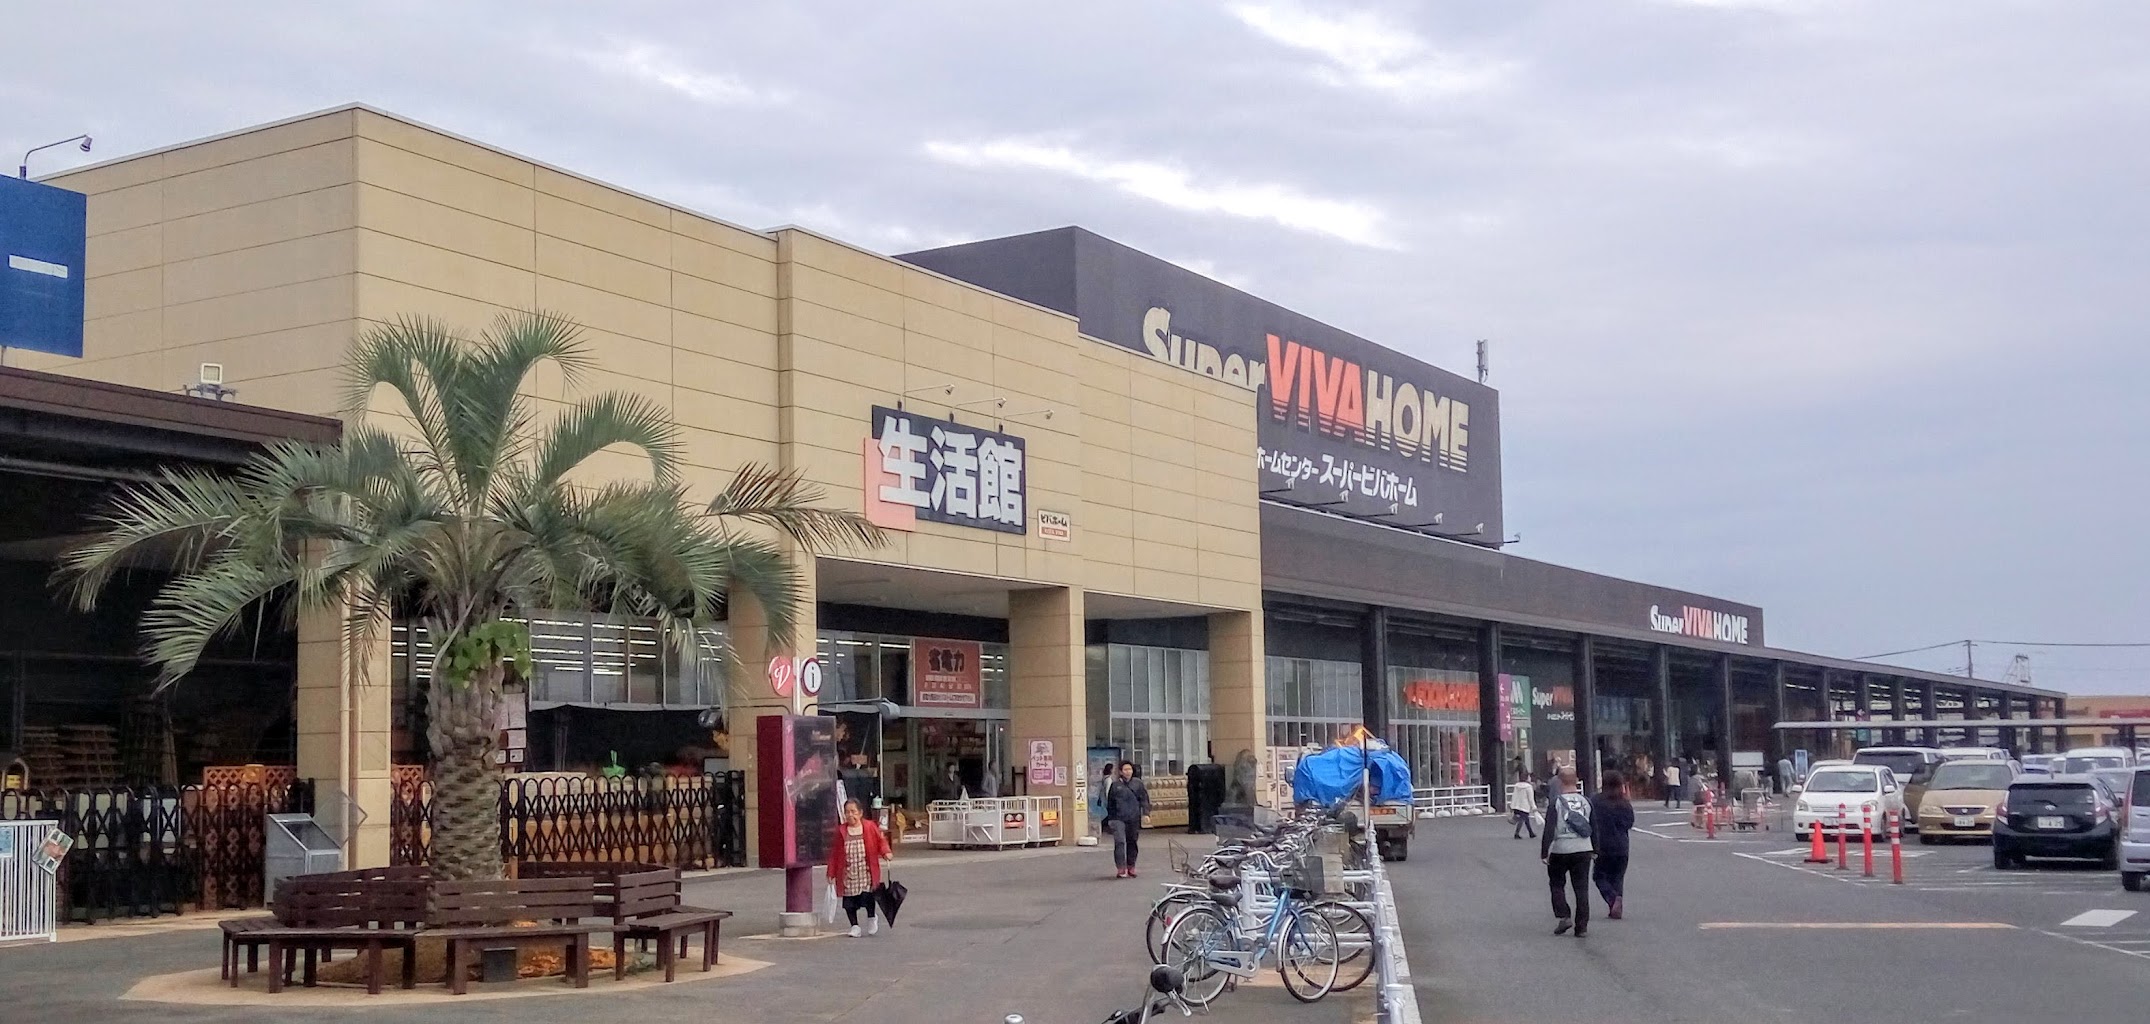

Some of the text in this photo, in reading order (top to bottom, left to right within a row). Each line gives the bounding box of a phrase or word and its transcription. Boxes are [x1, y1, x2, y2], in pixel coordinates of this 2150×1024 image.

[878, 415, 1023, 527] 生活館
[1320, 454, 1418, 507] スーパービバホーム
